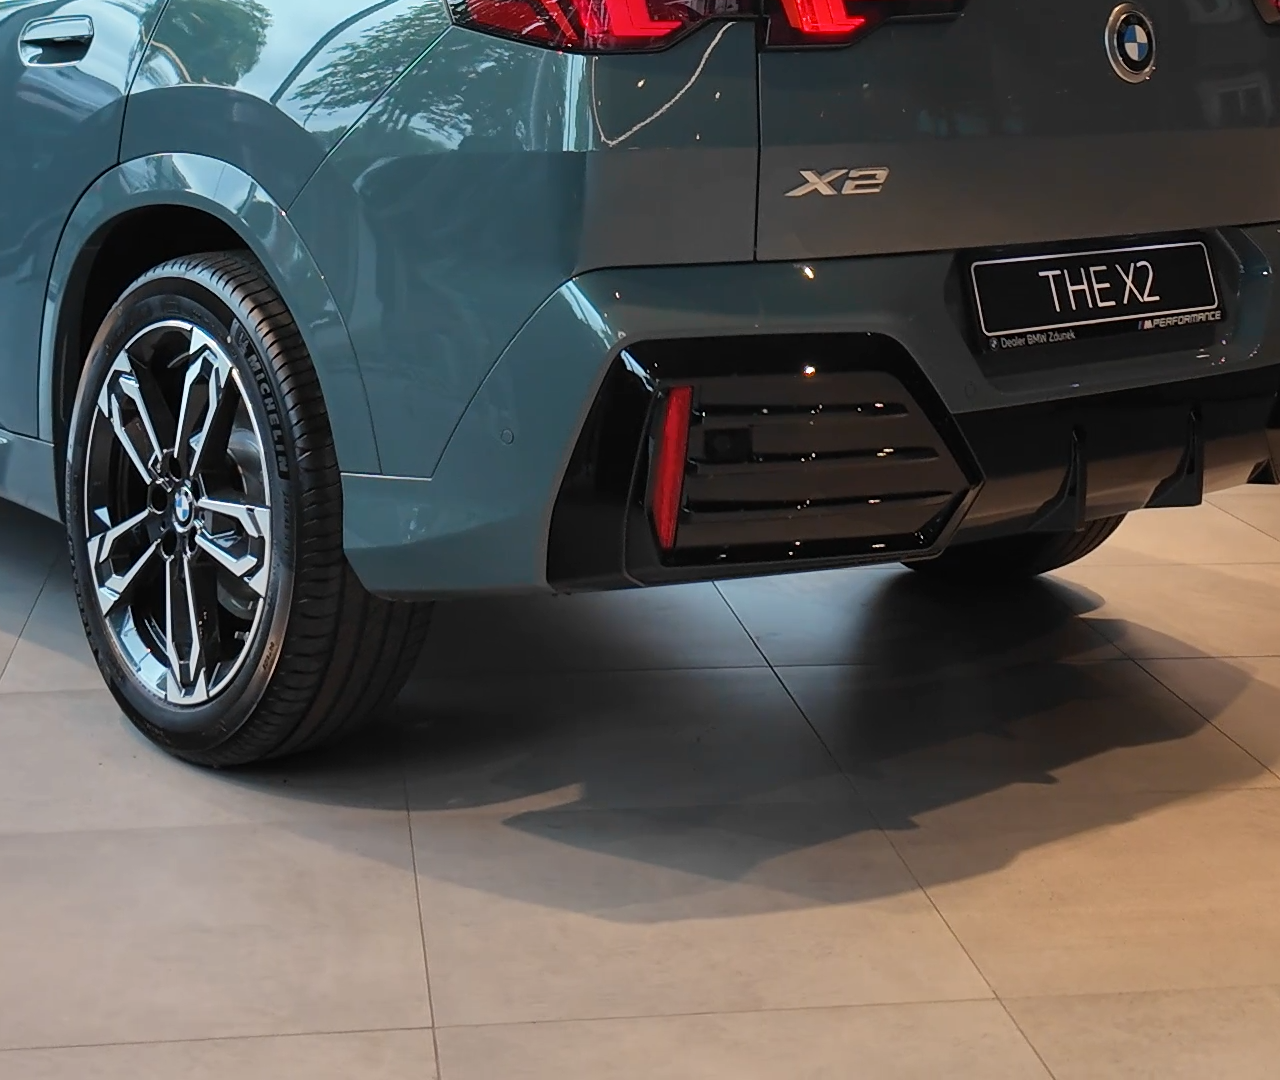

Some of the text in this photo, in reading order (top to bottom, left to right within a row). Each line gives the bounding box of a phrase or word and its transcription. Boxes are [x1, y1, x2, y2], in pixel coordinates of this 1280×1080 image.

[784, 167, 890, 197] X2
[1038, 260, 1160, 312] THE X2
[1026, 332, 1047, 345] BMW
[247, 354, 289, 473] MICHELIN
